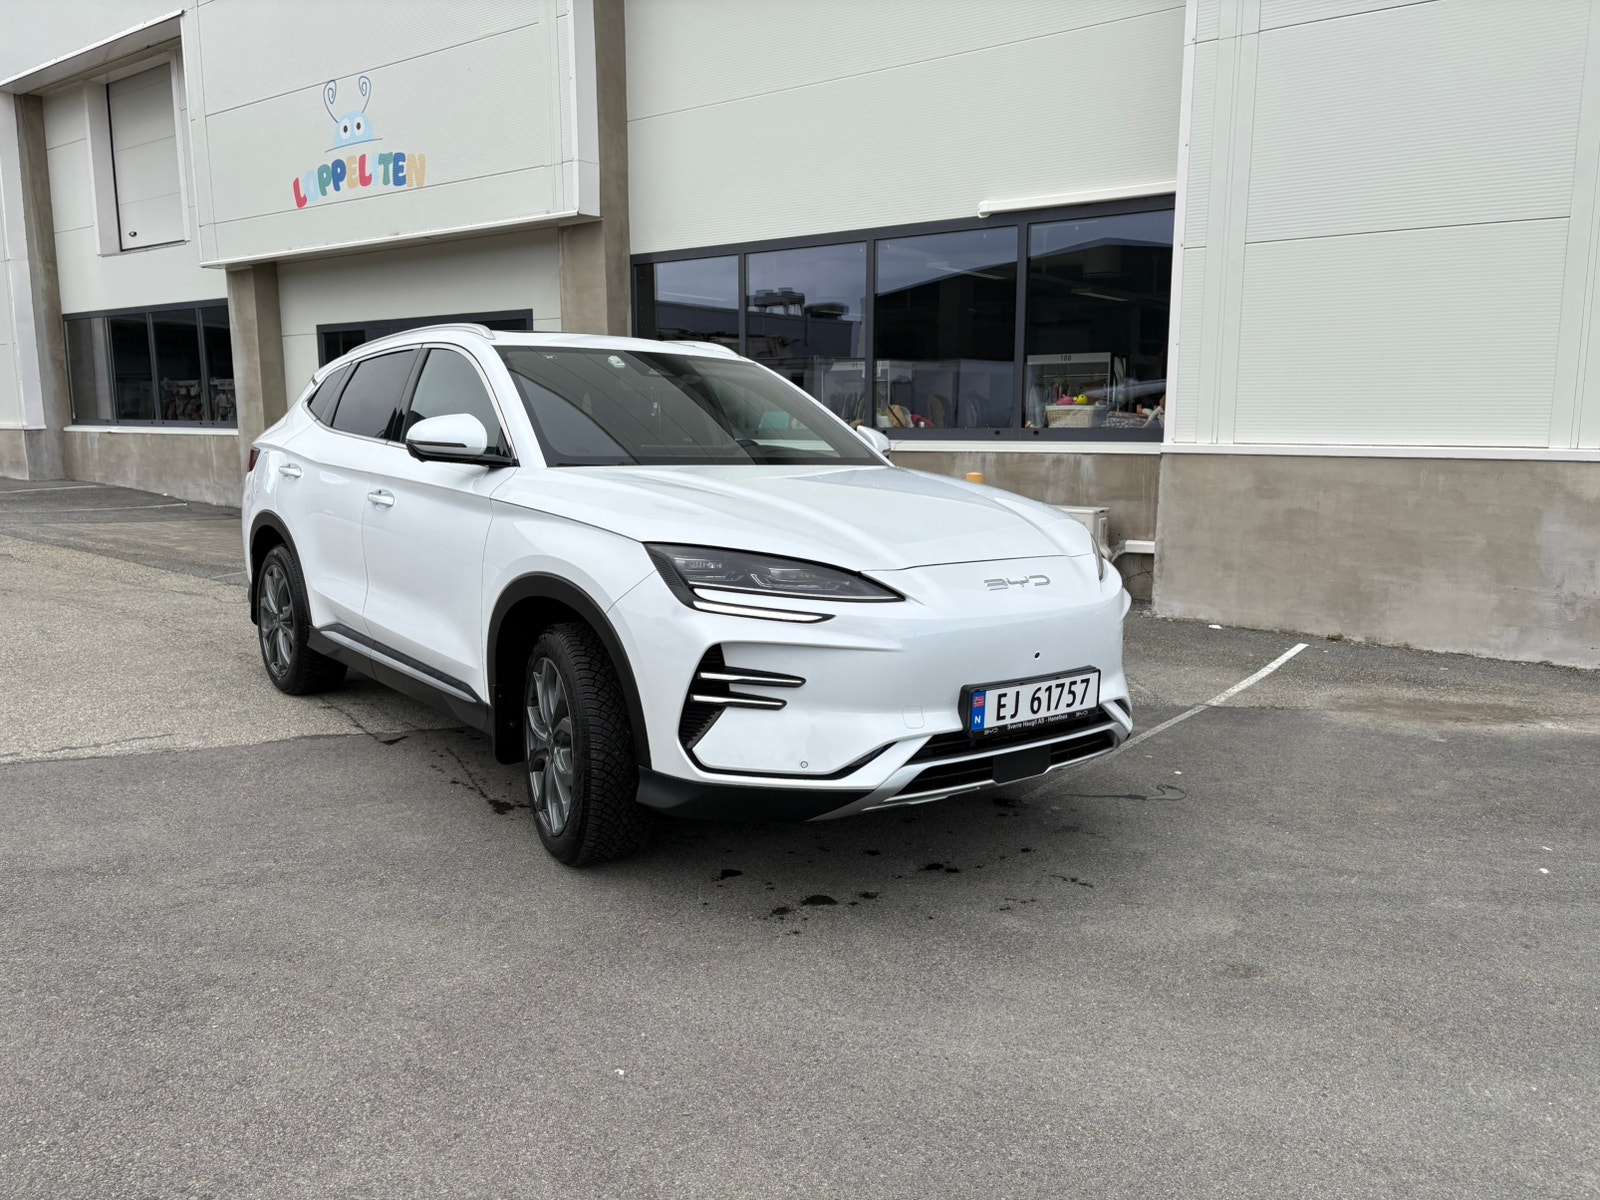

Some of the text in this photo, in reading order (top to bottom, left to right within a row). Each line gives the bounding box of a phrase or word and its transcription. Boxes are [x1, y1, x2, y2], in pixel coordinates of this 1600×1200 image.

[293, 152, 426, 208] LOPPELITEN
[983, 574, 1051, 591] BYD
[996, 677, 1091, 722] EJ 61757
[974, 715, 981, 724] N
